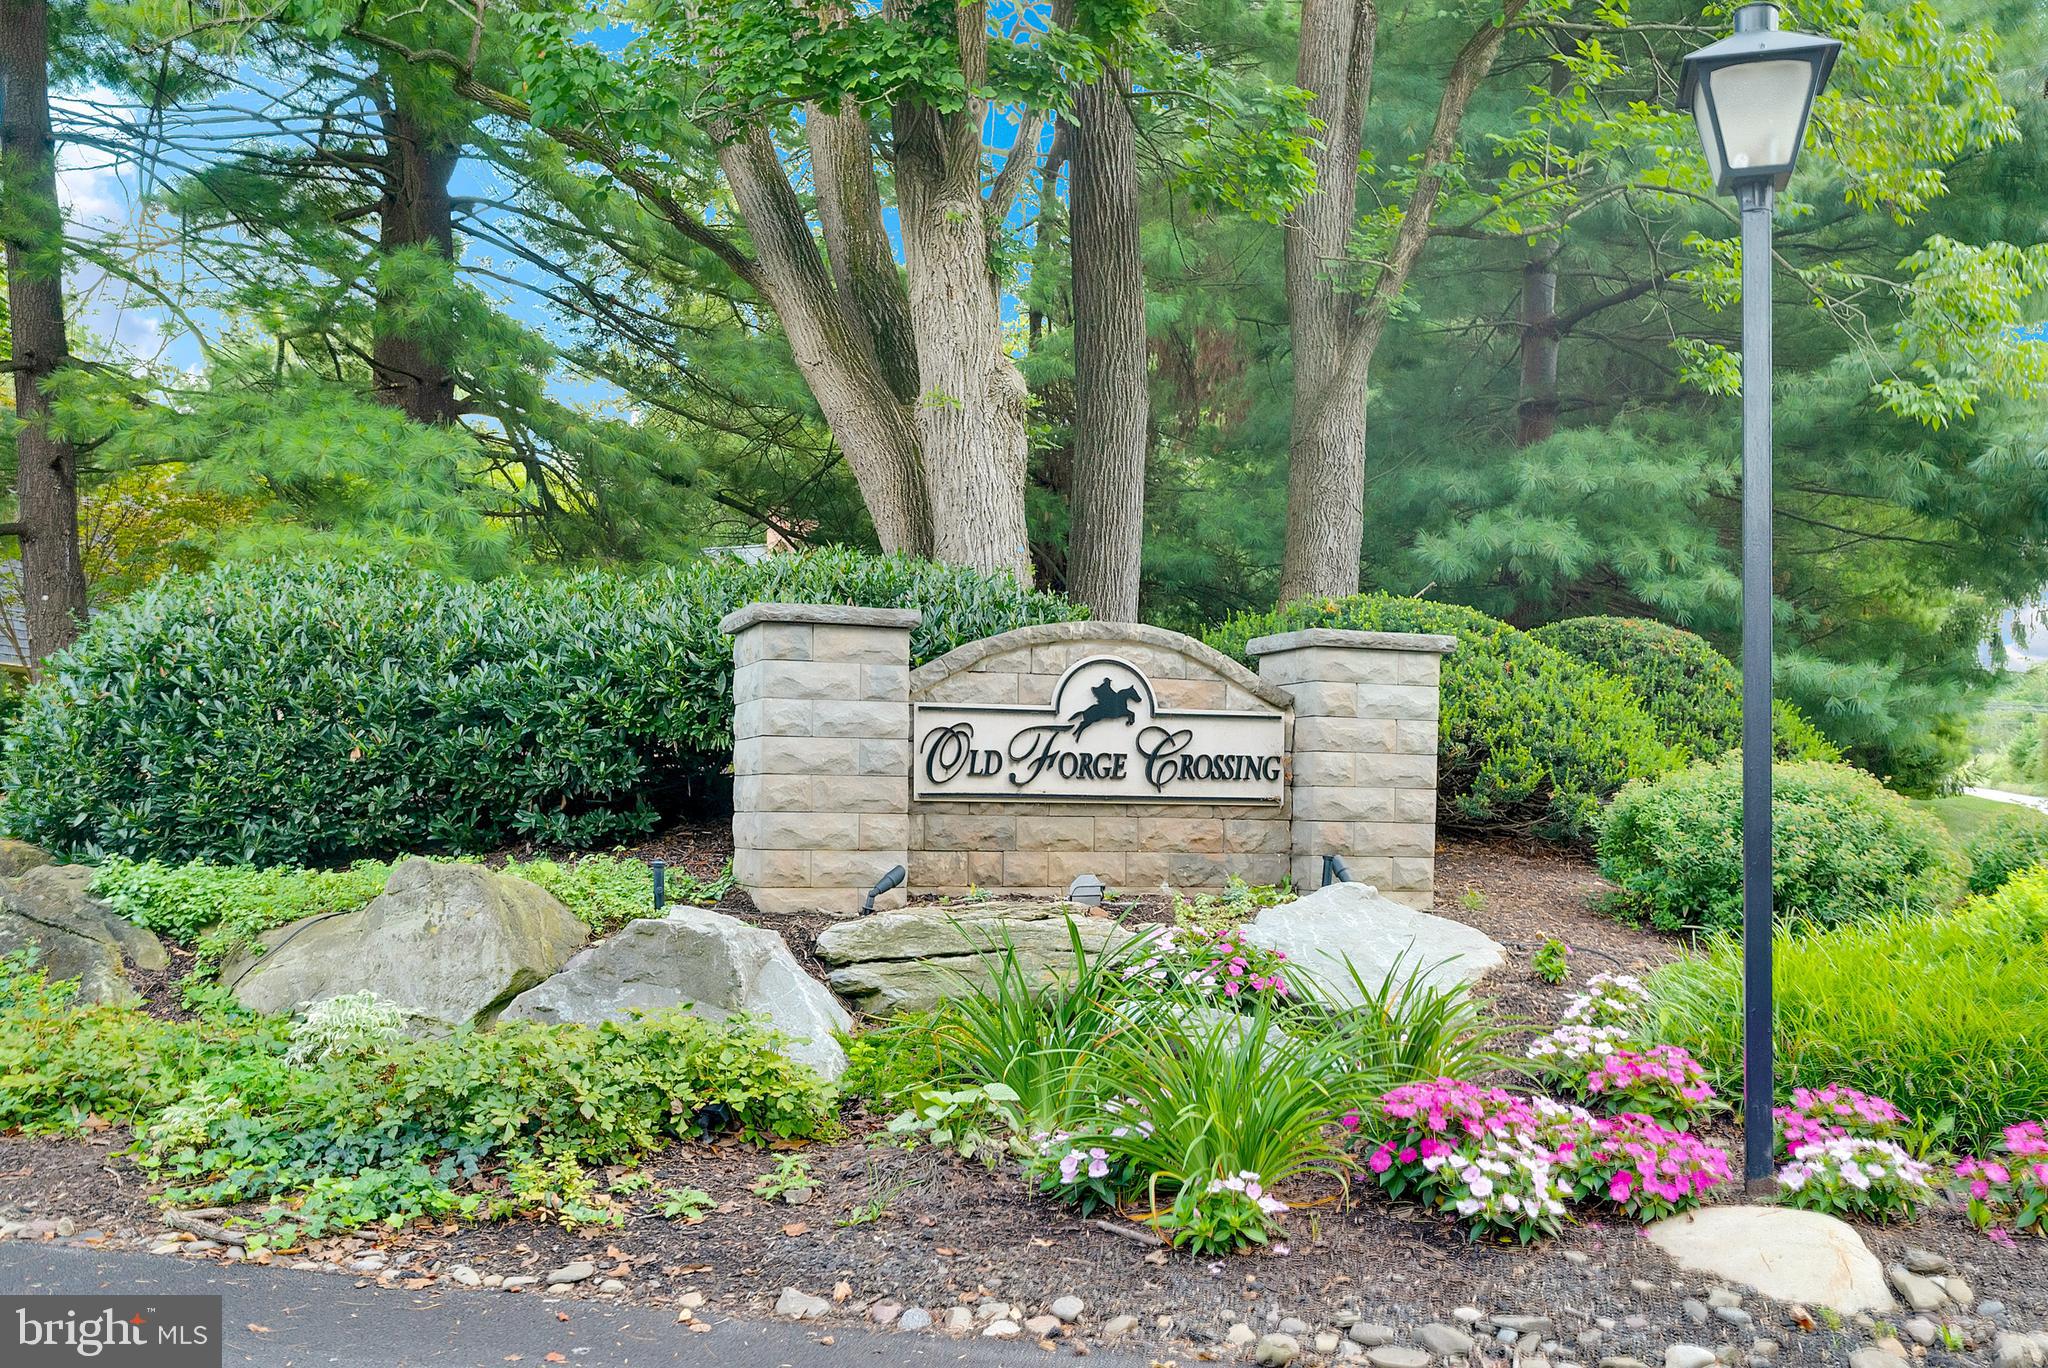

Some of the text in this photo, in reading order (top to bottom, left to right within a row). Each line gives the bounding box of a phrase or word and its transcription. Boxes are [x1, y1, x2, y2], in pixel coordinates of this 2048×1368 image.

[920, 721, 1282, 793] OLD FORGE CROSSING
